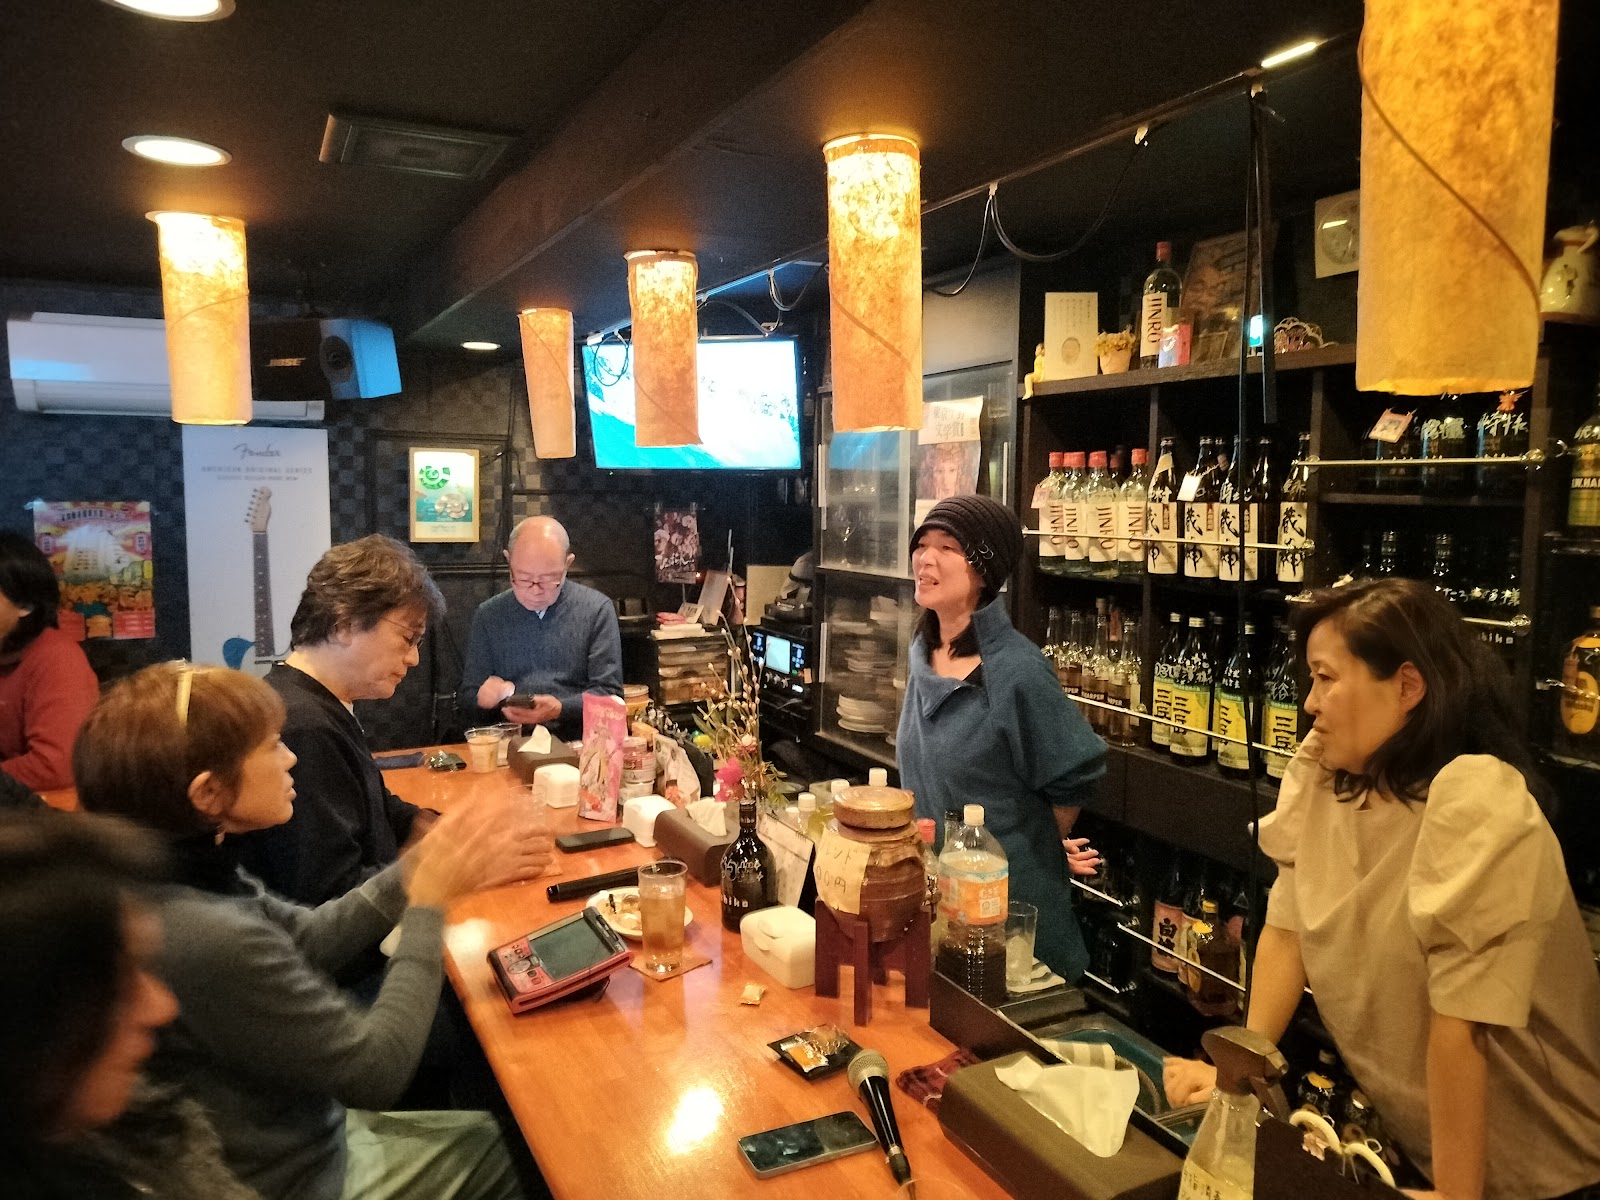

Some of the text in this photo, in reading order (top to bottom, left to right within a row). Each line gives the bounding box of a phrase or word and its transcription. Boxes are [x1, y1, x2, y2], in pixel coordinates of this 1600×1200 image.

[1147, 297, 1162, 344] JINRO
[233, 443, 281, 459] Fender
[1050, 504, 1064, 546] JINRO
[1096, 506, 1115, 550] JINRO
[1127, 505, 1144, 550] JINRO
